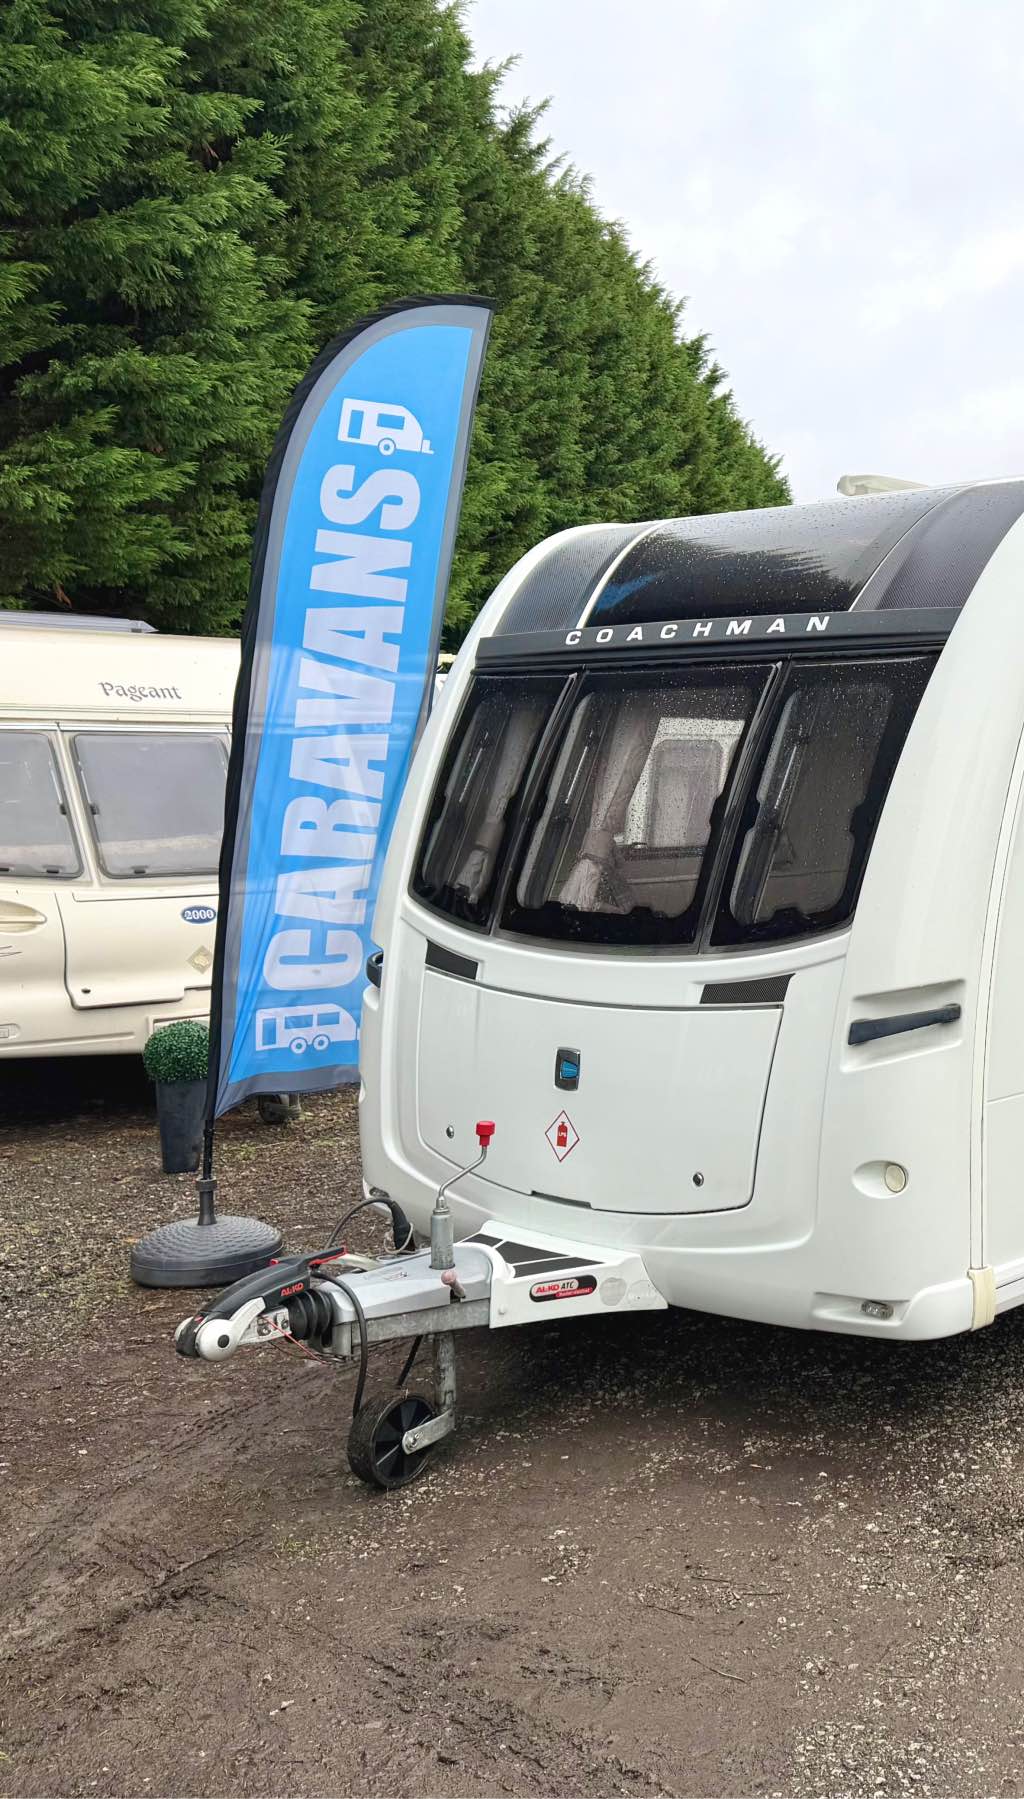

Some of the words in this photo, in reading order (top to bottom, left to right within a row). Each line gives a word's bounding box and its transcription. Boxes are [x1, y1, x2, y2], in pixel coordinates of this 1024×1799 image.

[565, 616, 830, 646] COACHMAN
[98, 682, 183, 702] Pageant
[263, 463, 421, 991] CARAVANS
[184, 909, 214, 920] 2000
[561, 1280, 575, 1290] ATC
